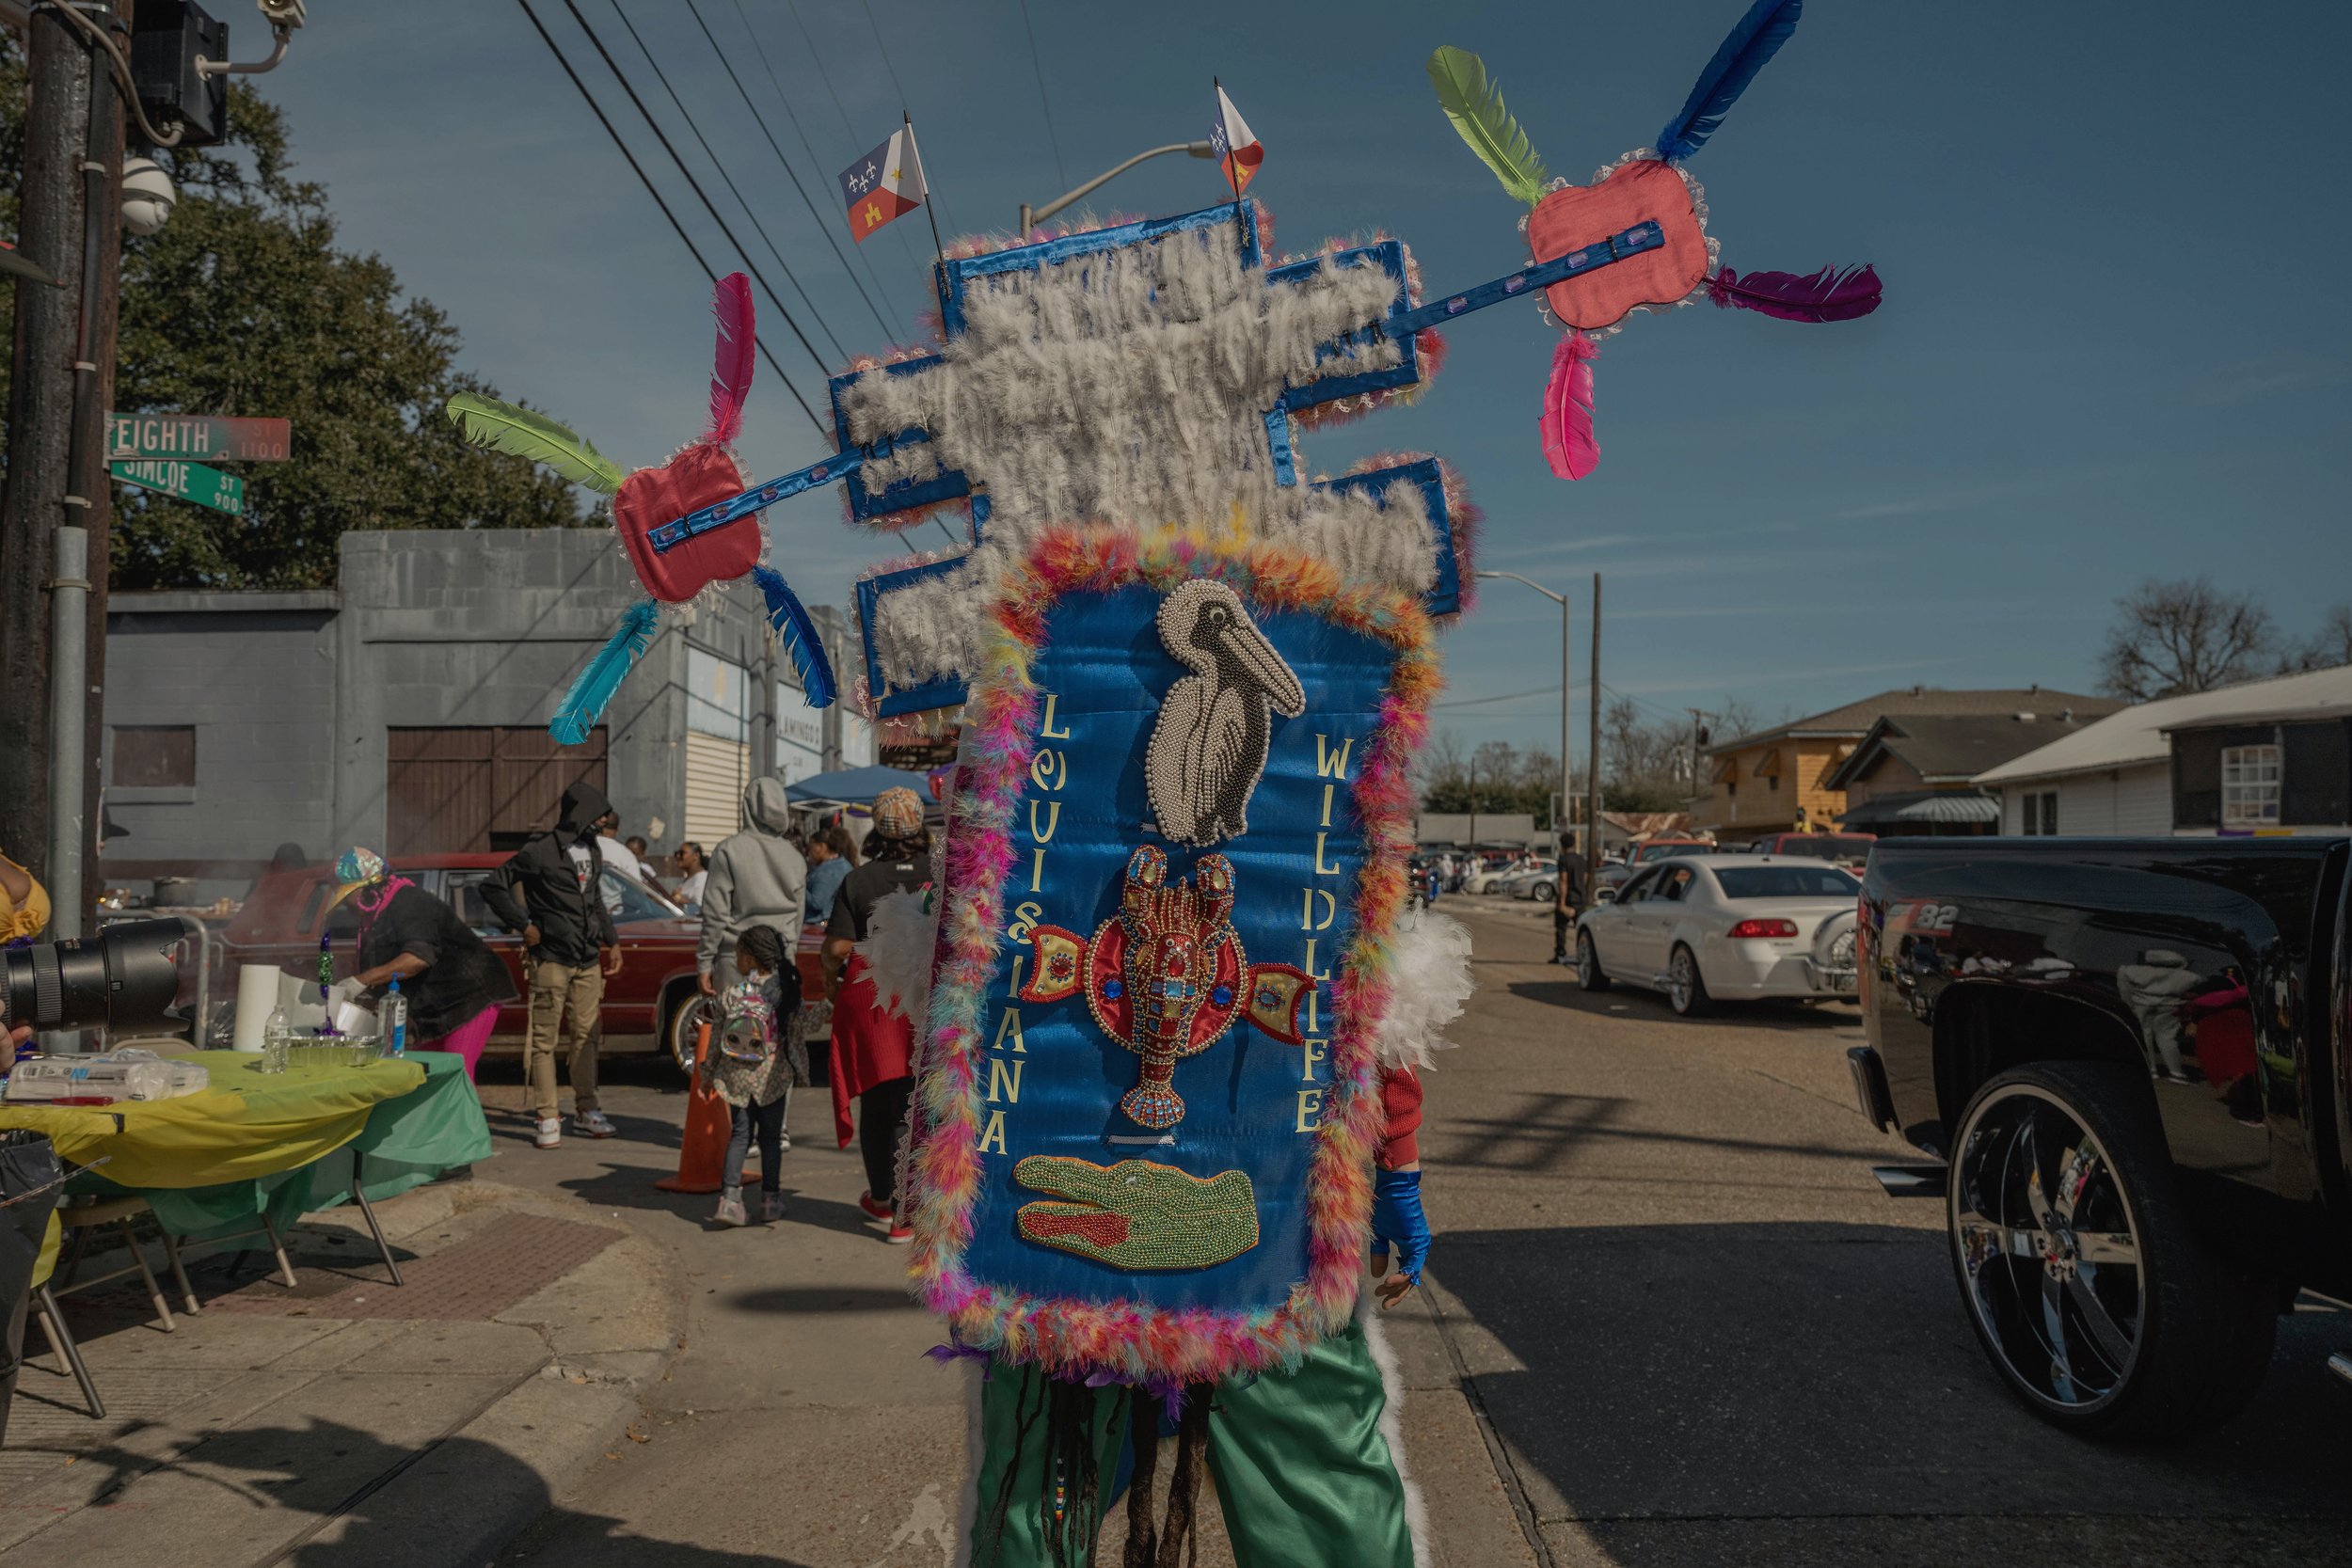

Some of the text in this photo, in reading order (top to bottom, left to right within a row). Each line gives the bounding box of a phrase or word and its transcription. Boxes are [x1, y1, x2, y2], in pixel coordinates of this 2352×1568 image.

[117, 420, 274, 452] EIGHTH ST
[241, 442, 282, 459] 1100
[220, 476, 234, 492] ST
[215, 492, 239, 512] 900
[977, 694, 1070, 1155] LOUISIANA
[1295, 734, 1354, 1133] WILDLIFE
